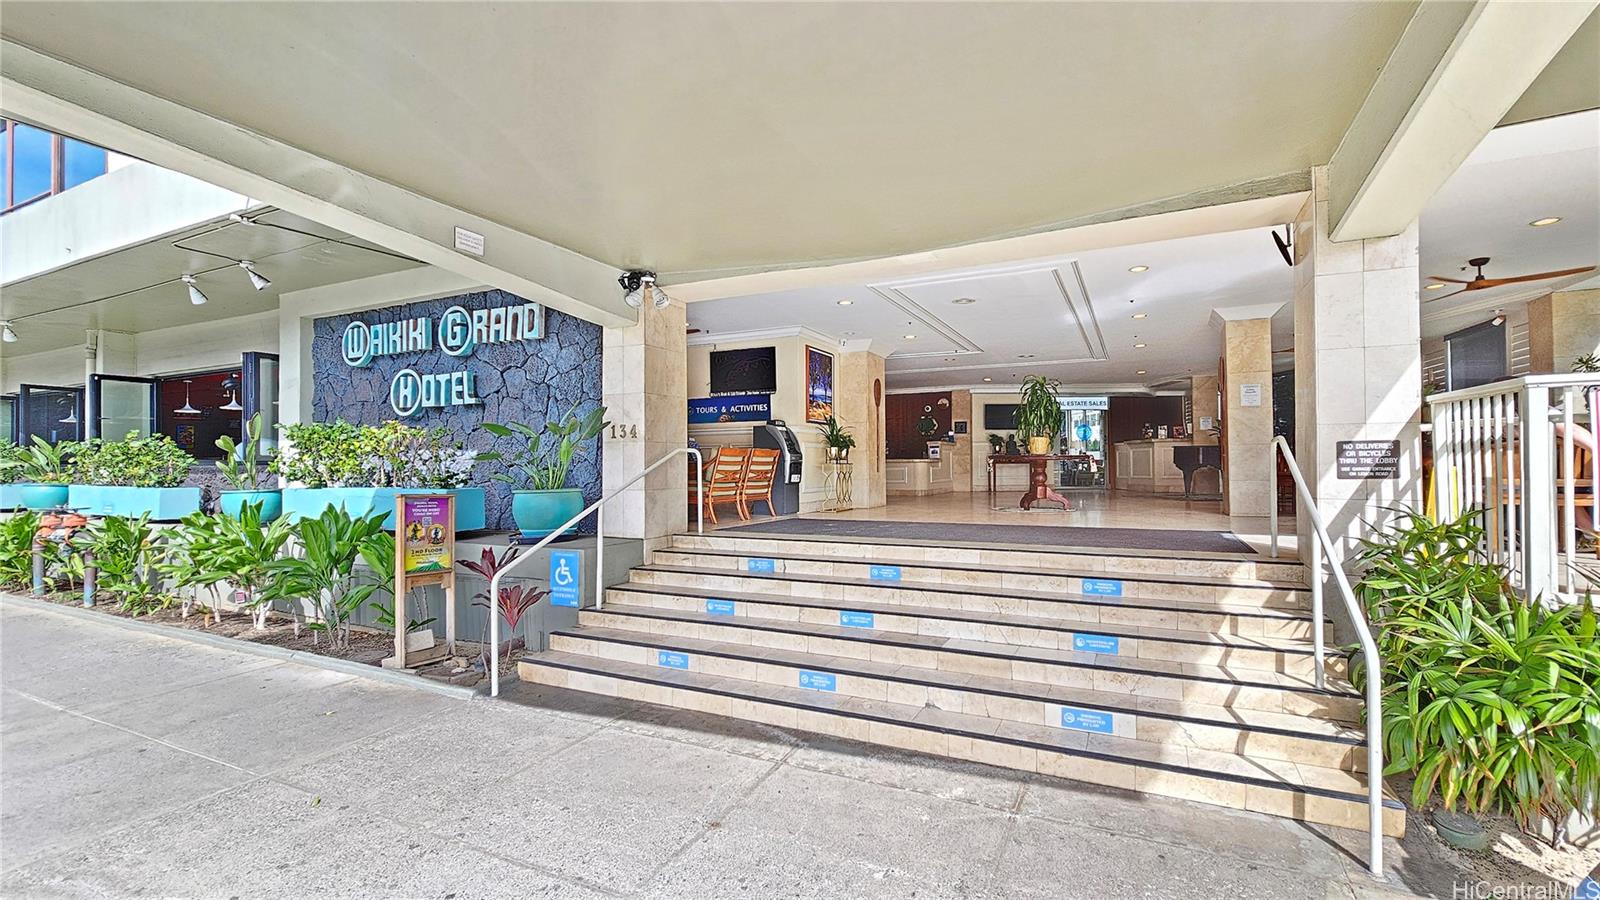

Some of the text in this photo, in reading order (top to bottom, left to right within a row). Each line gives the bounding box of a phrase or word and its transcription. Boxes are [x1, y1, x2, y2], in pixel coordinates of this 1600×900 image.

[342, 303, 545, 367] WAIKIKI GRAND
[390, 368, 481, 416] HOTEL
[696, 403, 768, 414] TOURS & ACTIVITIES
[611, 424, 638, 439] 134
